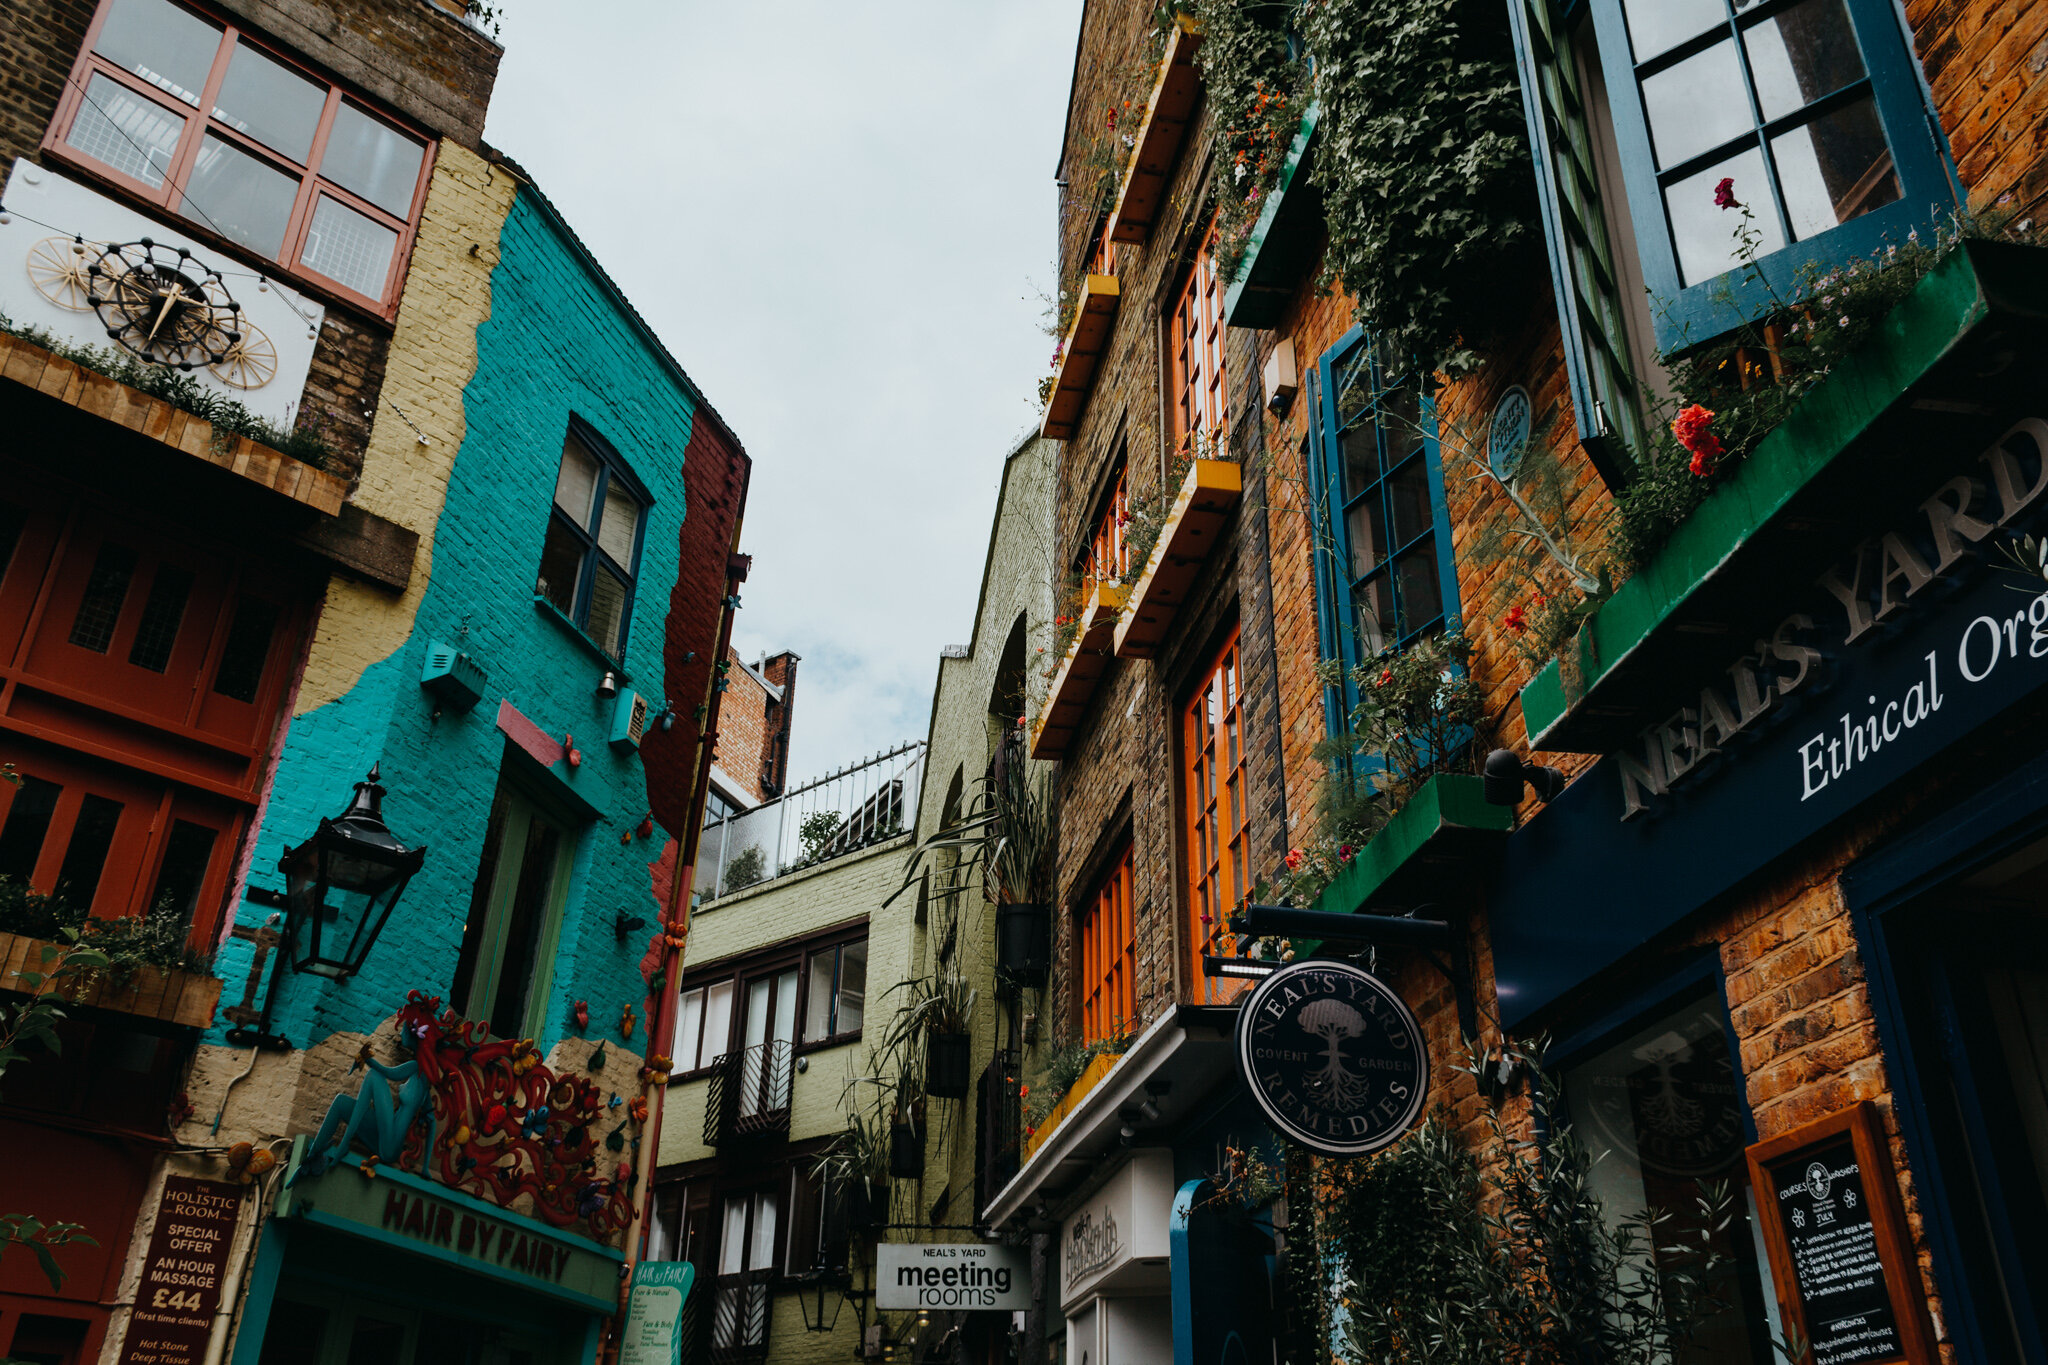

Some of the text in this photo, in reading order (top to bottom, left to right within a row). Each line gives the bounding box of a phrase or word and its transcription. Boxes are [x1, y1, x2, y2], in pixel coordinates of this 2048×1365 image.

[1613, 416, 2048, 822] NEAL'S YARD
[1798, 649, 1943, 802] Ethical
[1256, 974, 1409, 1050] NEAL'S YARD
[1255, 1047, 1413, 1072] COVENT GARDEN
[1262, 1071, 1408, 1137] REMEDIES
[196, 1186, 210, 1194] THE
[1780, 1181, 1809, 1200] COURSES
[165, 1190, 236, 1210] HOLISTIC
[174, 1204, 220, 1220] ROOM
[1815, 1211, 1834, 1224] JULY
[168, 1224, 220, 1241] SPECIAL
[382, 1189, 571, 1280] HAIR BY FAIRY
[170, 1238, 212, 1254] OFFER
[923, 1249, 986, 1257] NEAL'S YARD
[156, 1257, 216, 1275] AN HOUR
[636, 1264, 655, 1284] HAIR
[662, 1266, 689, 1284] FAIRY
[150, 1270, 216, 1288] MASSAGE
[897, 1262, 1011, 1293] meeting
[151, 1288, 202, 1312] £44
[919, 1288, 996, 1306] rooms
[134, 1311, 210, 1329] (first time clients)
[139, 1339, 189, 1352] Hot Stone
[130, 1351, 190, 1365] Deep Tissue
